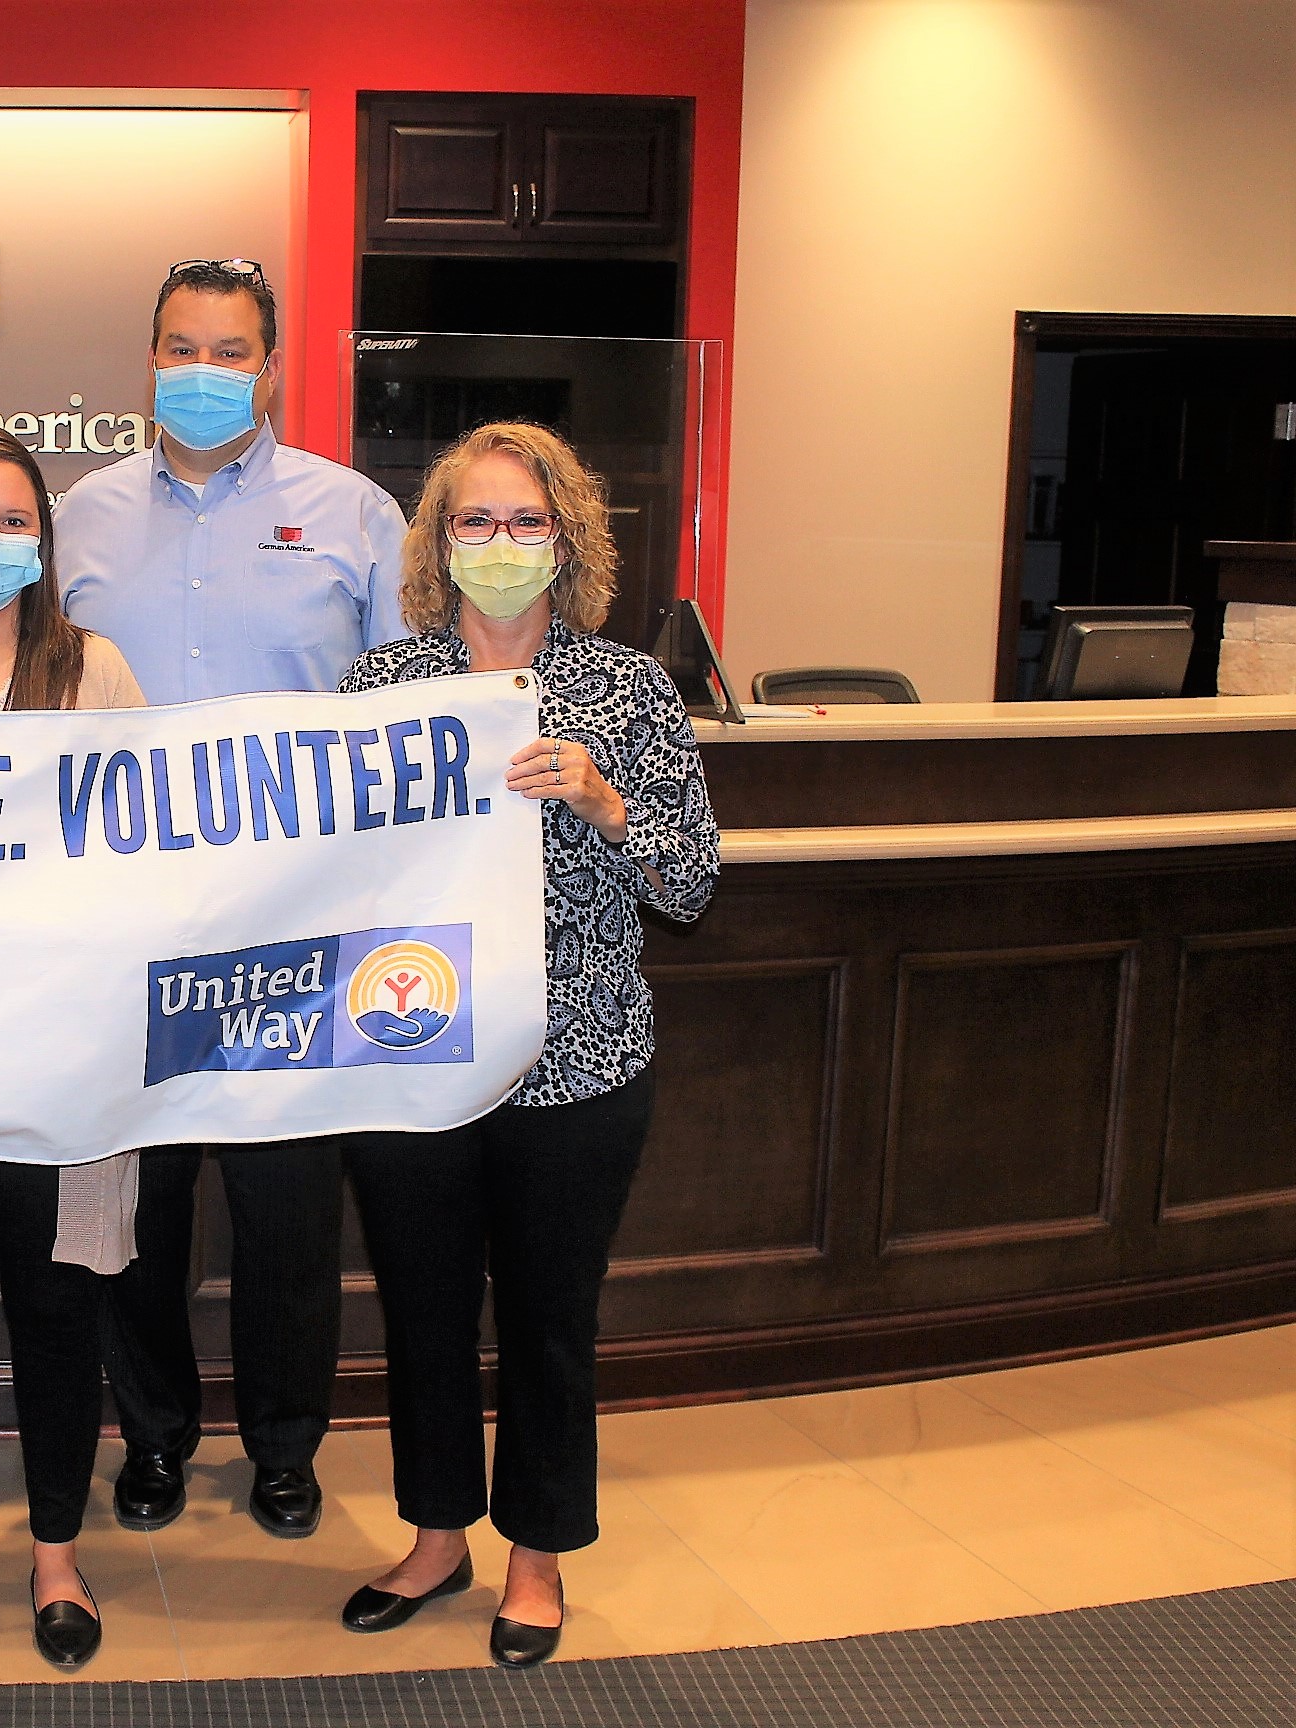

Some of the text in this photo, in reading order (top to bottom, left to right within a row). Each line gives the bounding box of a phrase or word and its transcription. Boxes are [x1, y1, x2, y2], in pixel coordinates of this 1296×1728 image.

[257, 542, 315, 552] German American
[58, 715, 492, 858] VOLUNTEER.
[157, 950, 325, 1017] United
[218, 1004, 323, 1061] Way
